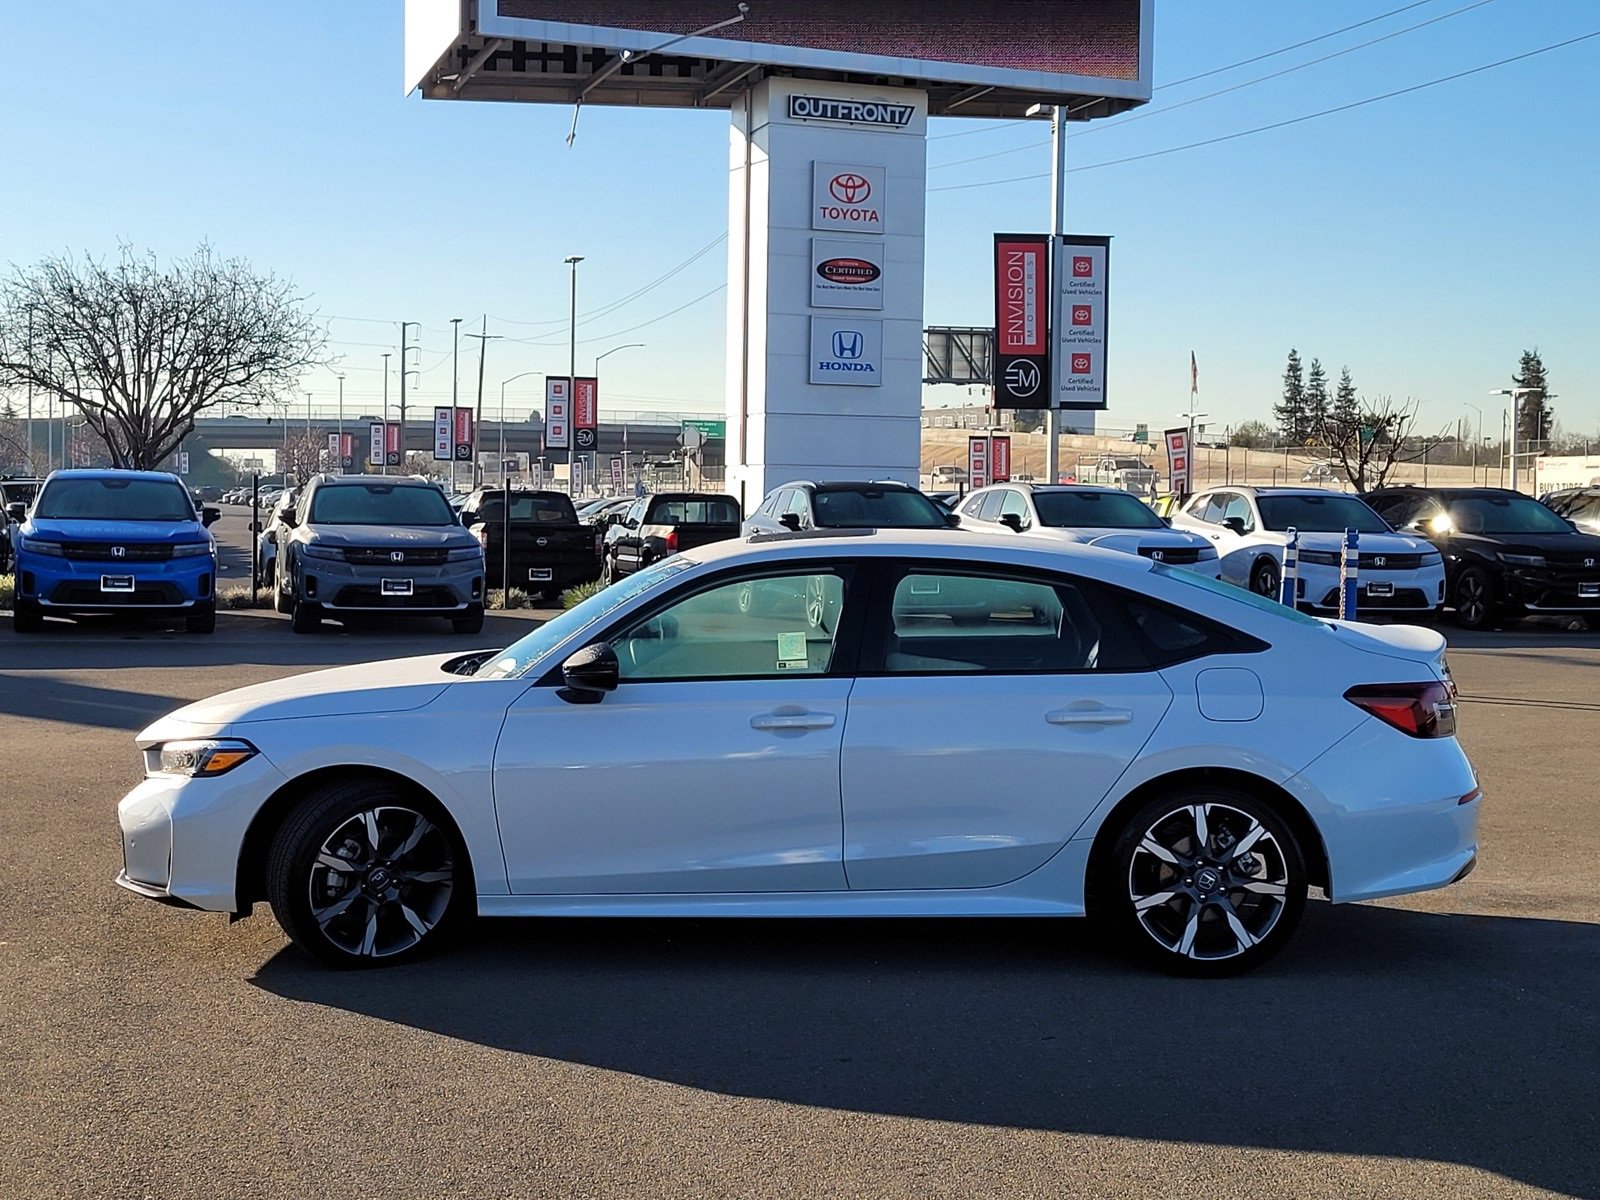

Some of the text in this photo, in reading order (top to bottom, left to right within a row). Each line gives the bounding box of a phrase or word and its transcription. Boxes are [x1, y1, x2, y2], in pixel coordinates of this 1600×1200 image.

[820, 206, 879, 222] TOYOTA
[825, 266, 873, 275] CERTIFIED
[1008, 251, 1024, 346] ENVISION
[819, 361, 875, 372] HONDA
[579, 383, 587, 424] ENVISION
[1540, 482, 1554, 492] BUY
